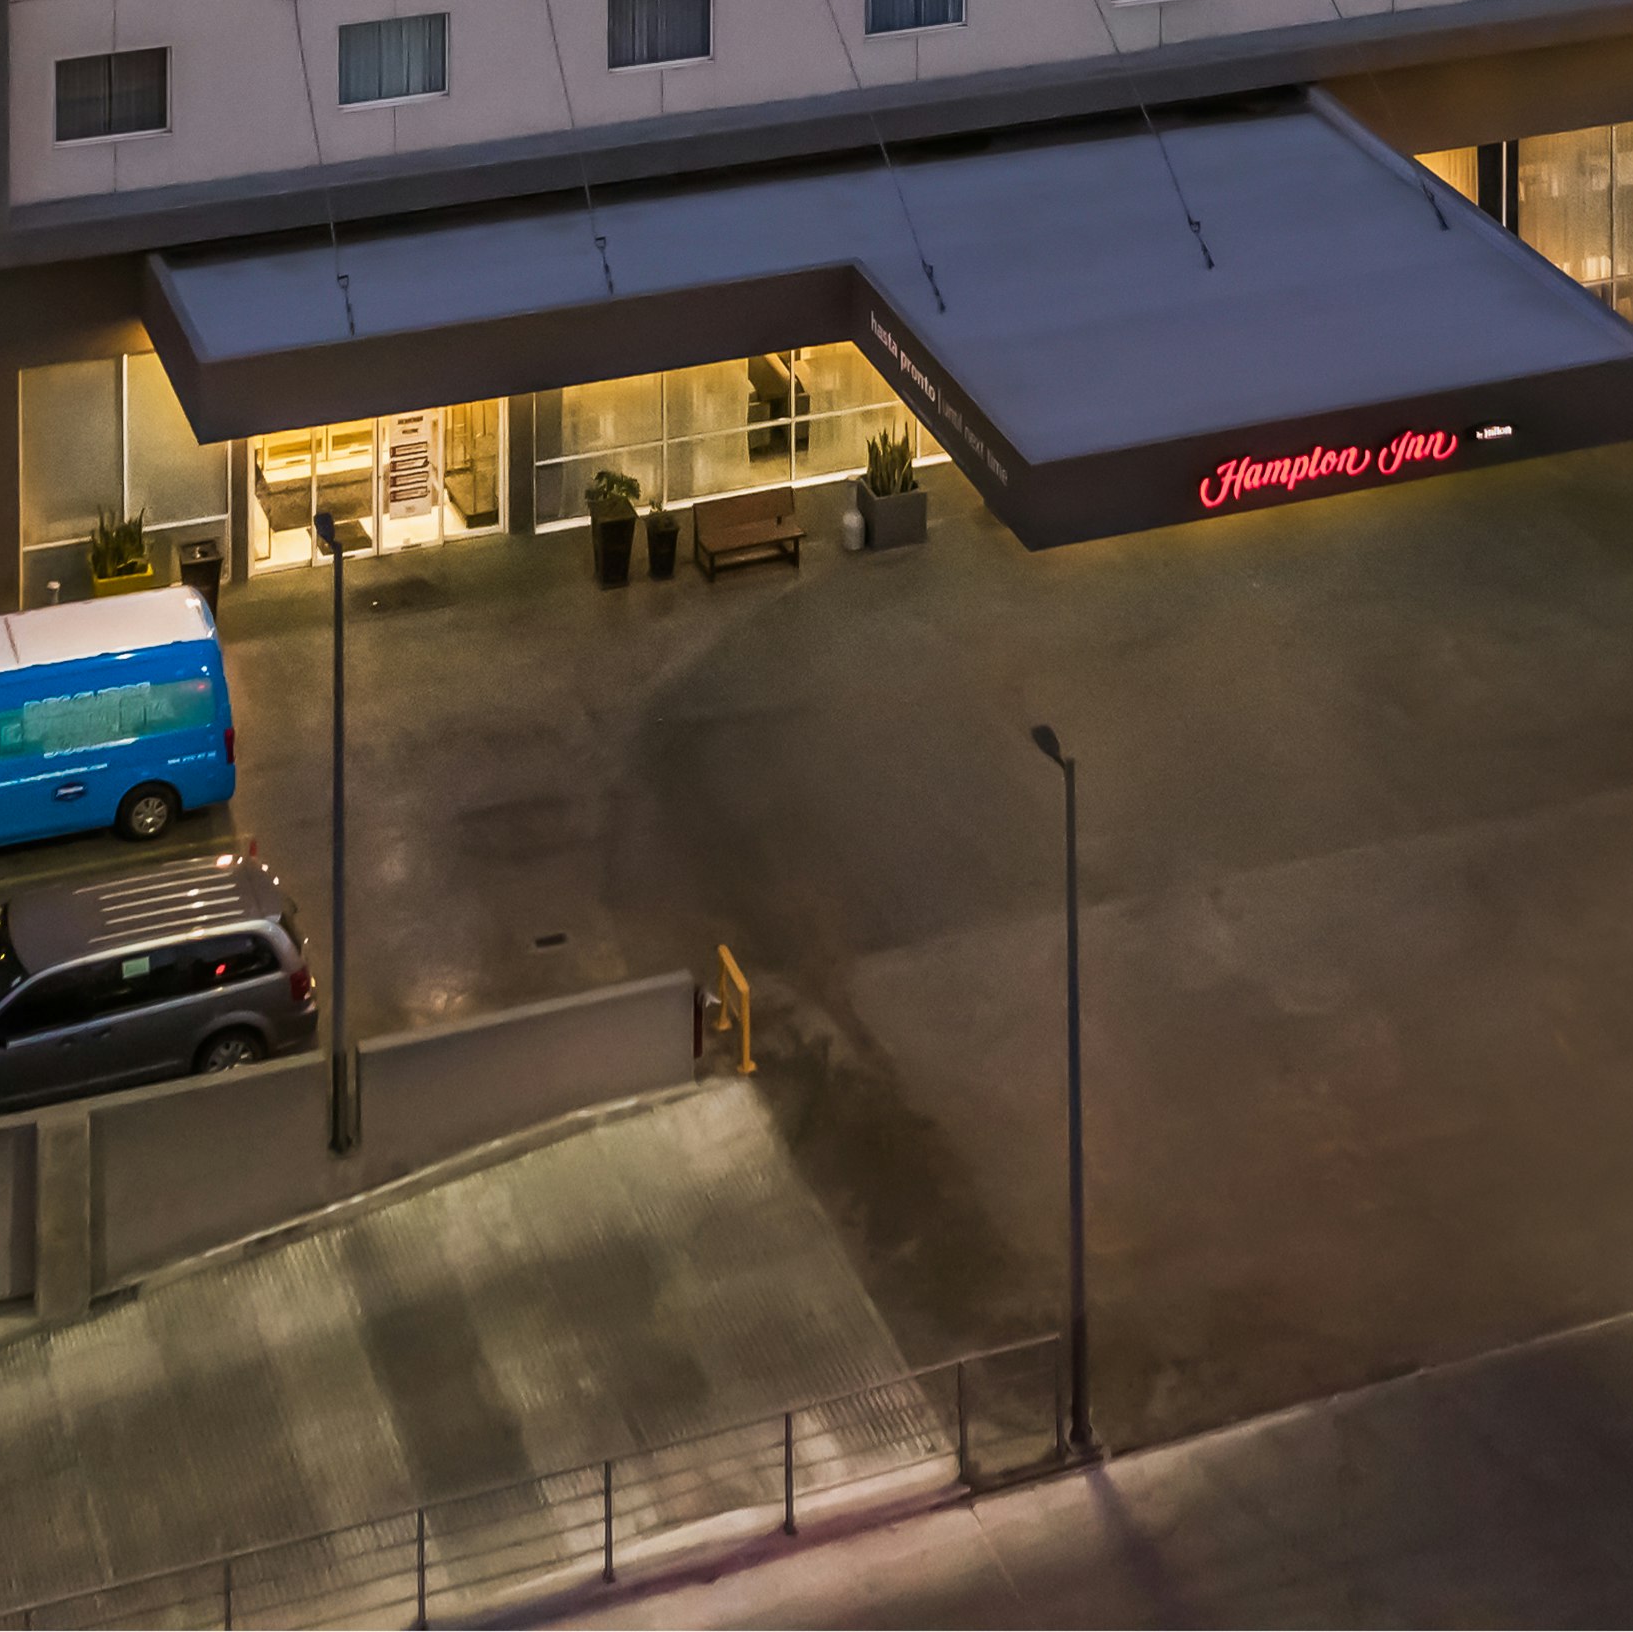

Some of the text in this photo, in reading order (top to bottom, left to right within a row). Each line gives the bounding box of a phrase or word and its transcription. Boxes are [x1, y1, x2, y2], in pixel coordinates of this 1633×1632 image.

[870, 310, 899, 360] hasta
[899, 349, 936, 403] pronto
[1200, 430, 1458, 508] Hampton Inn
